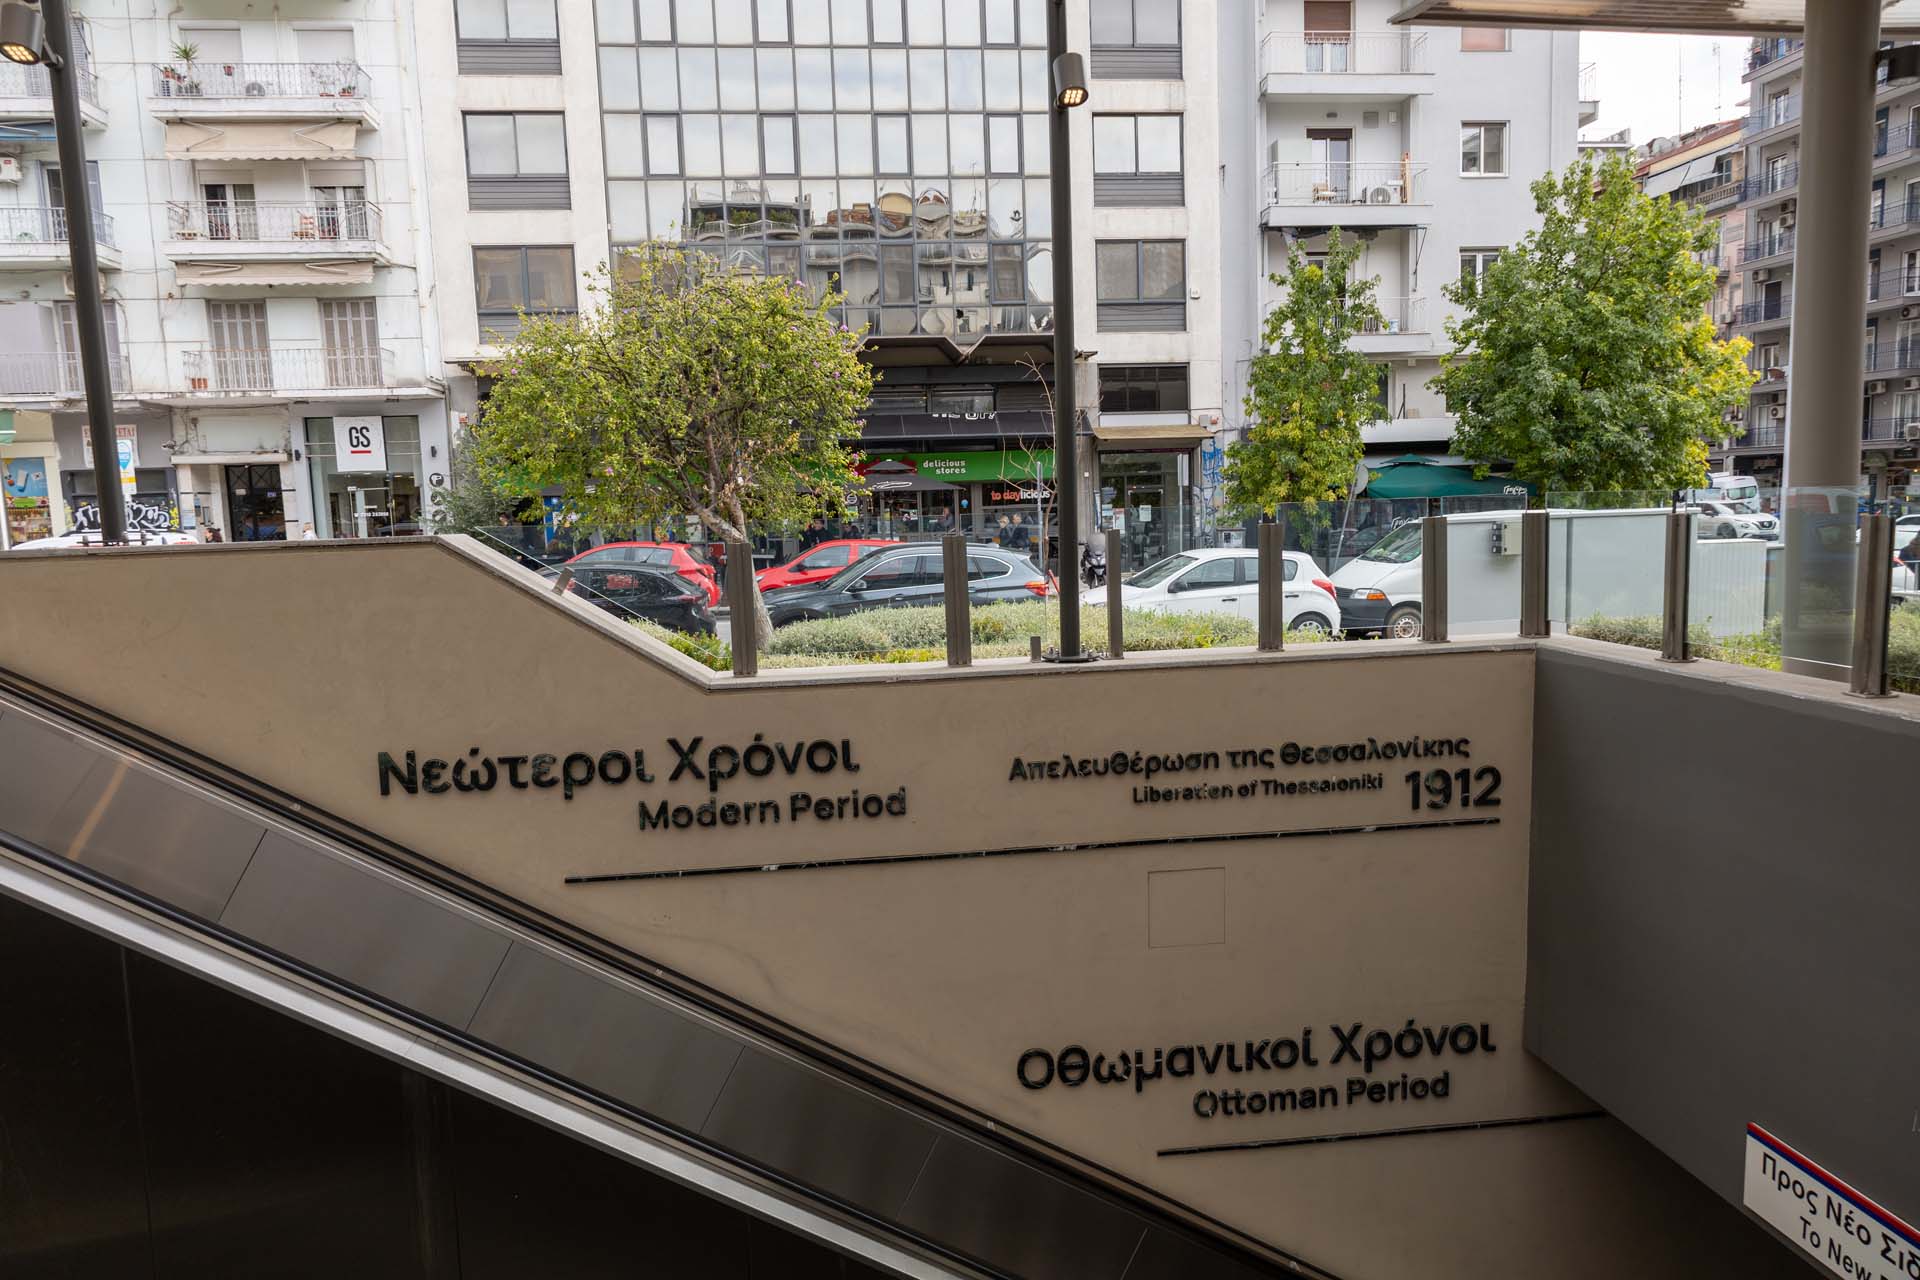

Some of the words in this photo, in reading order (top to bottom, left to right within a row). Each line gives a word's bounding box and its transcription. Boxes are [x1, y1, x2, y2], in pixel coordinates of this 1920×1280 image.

[348, 426, 371, 448] GS
[923, 460, 966, 468] delicious
[935, 467, 966, 475] stores
[991, 490, 1001, 500] to
[378, 747, 655, 801] Νεώτεροι
[667, 733, 860, 792] Χρόνοι
[1009, 751, 1219, 781] Απελευθέρωση
[1226, 748, 1275, 769] της
[1280, 736, 1471, 765] Θεσσαλονίκης
[639, 797, 780, 830] Modern
[790, 786, 907, 822] Period
[1133, 783, 1233, 804] Liberation
[1237, 780, 1258, 799] of
[1260, 773, 1383, 797] Thessaloniki
[1405, 765, 1502, 811] 1912
[1017, 1027, 1318, 1093] Οθωμανικοί
[1329, 1017, 1497, 1073] Χρόνοι
[1193, 1084, 1338, 1118] Ottoman
[1347, 1070, 1450, 1105] Period
[1763, 1152, 1818, 1216] Προς
[1826, 1195, 1871, 1246] Νέο
[1800, 1216, 1821, 1249] To
[1828, 1237, 1871, 1280] New
